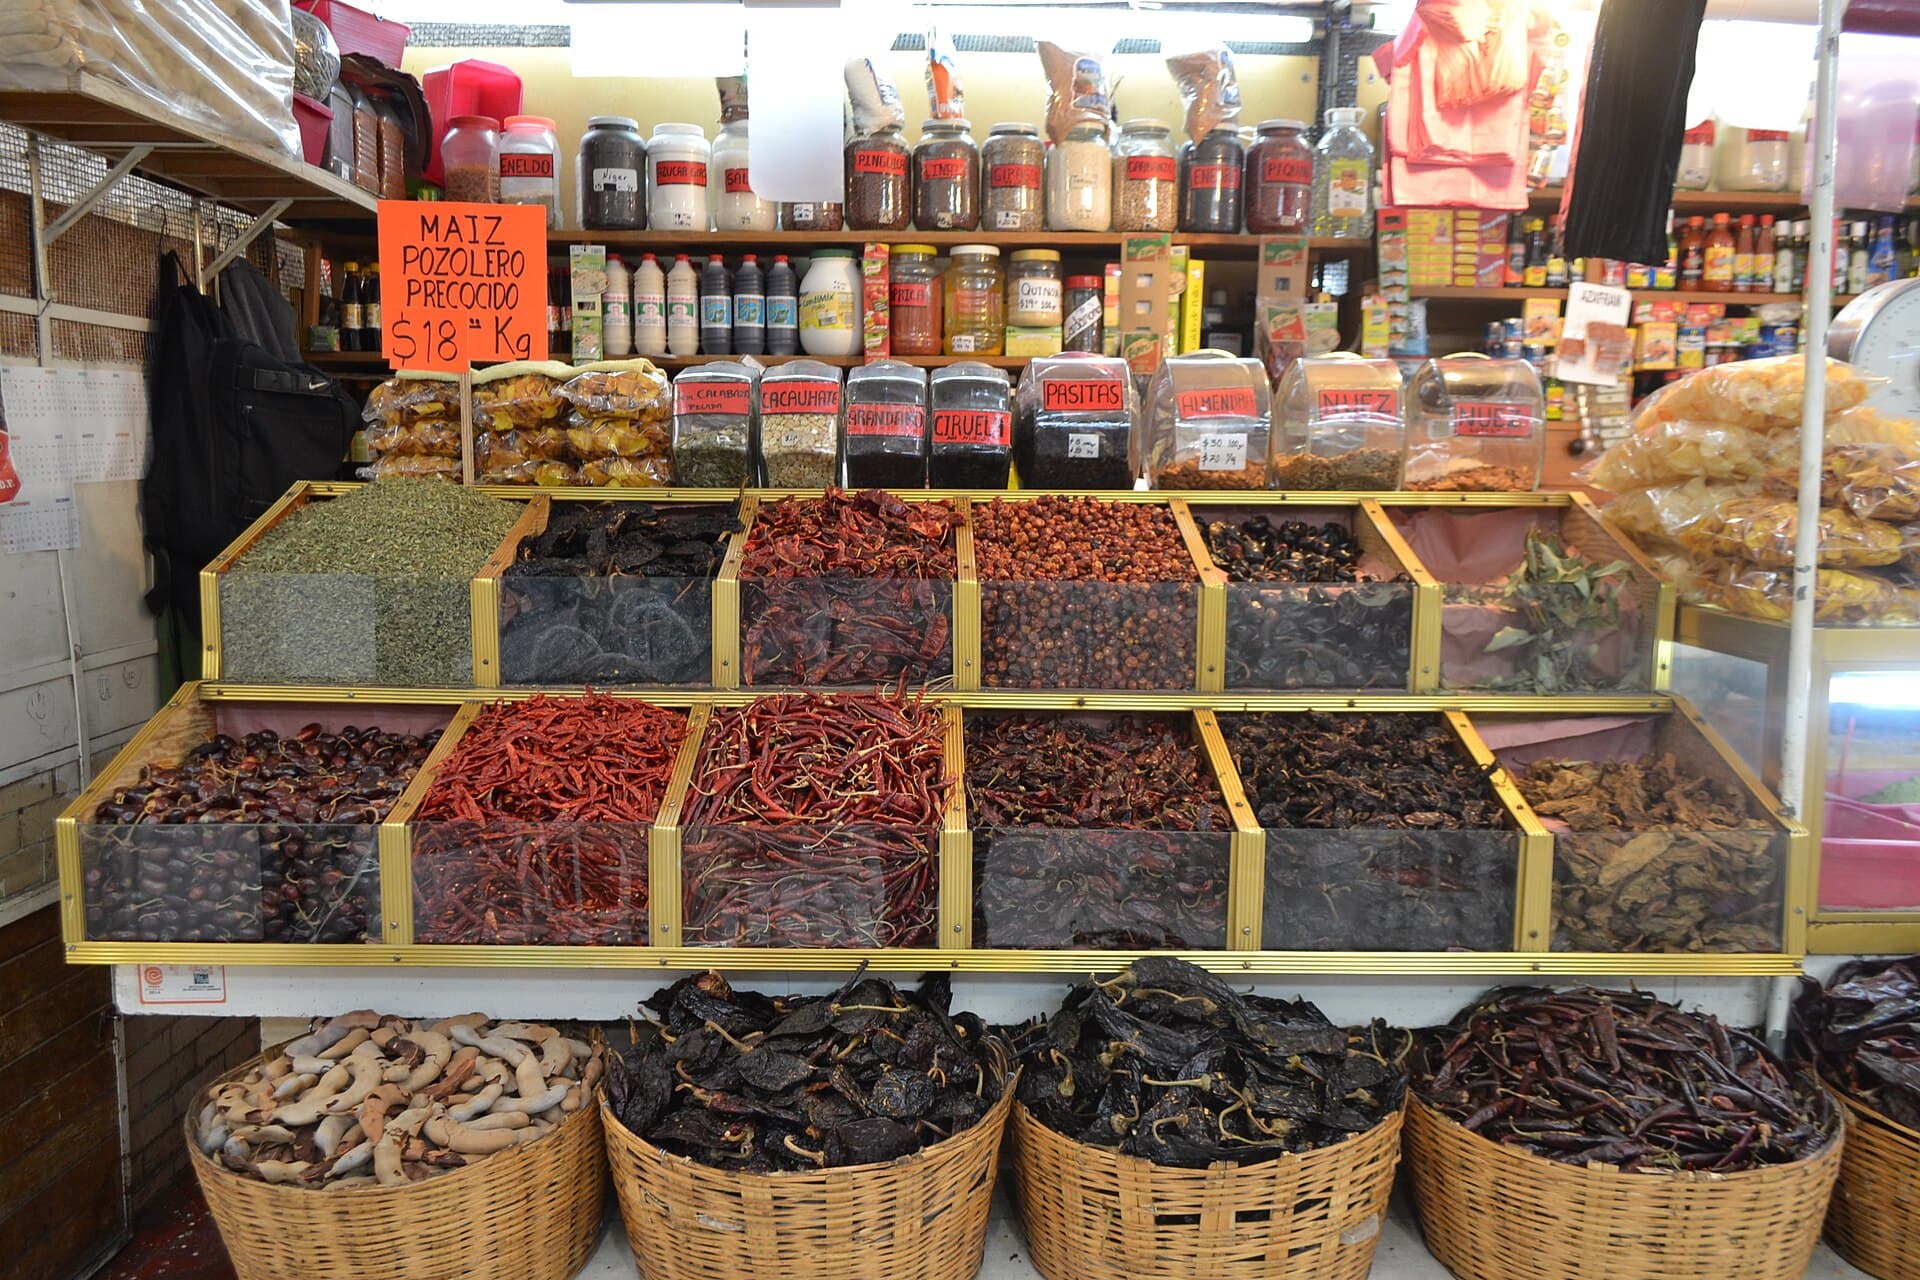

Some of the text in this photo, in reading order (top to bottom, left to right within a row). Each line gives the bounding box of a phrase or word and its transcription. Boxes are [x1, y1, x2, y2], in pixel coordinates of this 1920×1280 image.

[500, 158, 551, 175] ENELDO
[420, 214, 505, 246] MAIZ
[402, 245, 526, 278] POZOLERO
[406, 278, 519, 311] PRECOCIDO
[494, 315, 531, 361] Kg
[1045, 383, 1120, 405] PASITAS
[1323, 393, 1393, 416] NUEZ
[848, 408, 924, 429] ARANDANO
[933, 414, 1005, 438] CIRUELA
